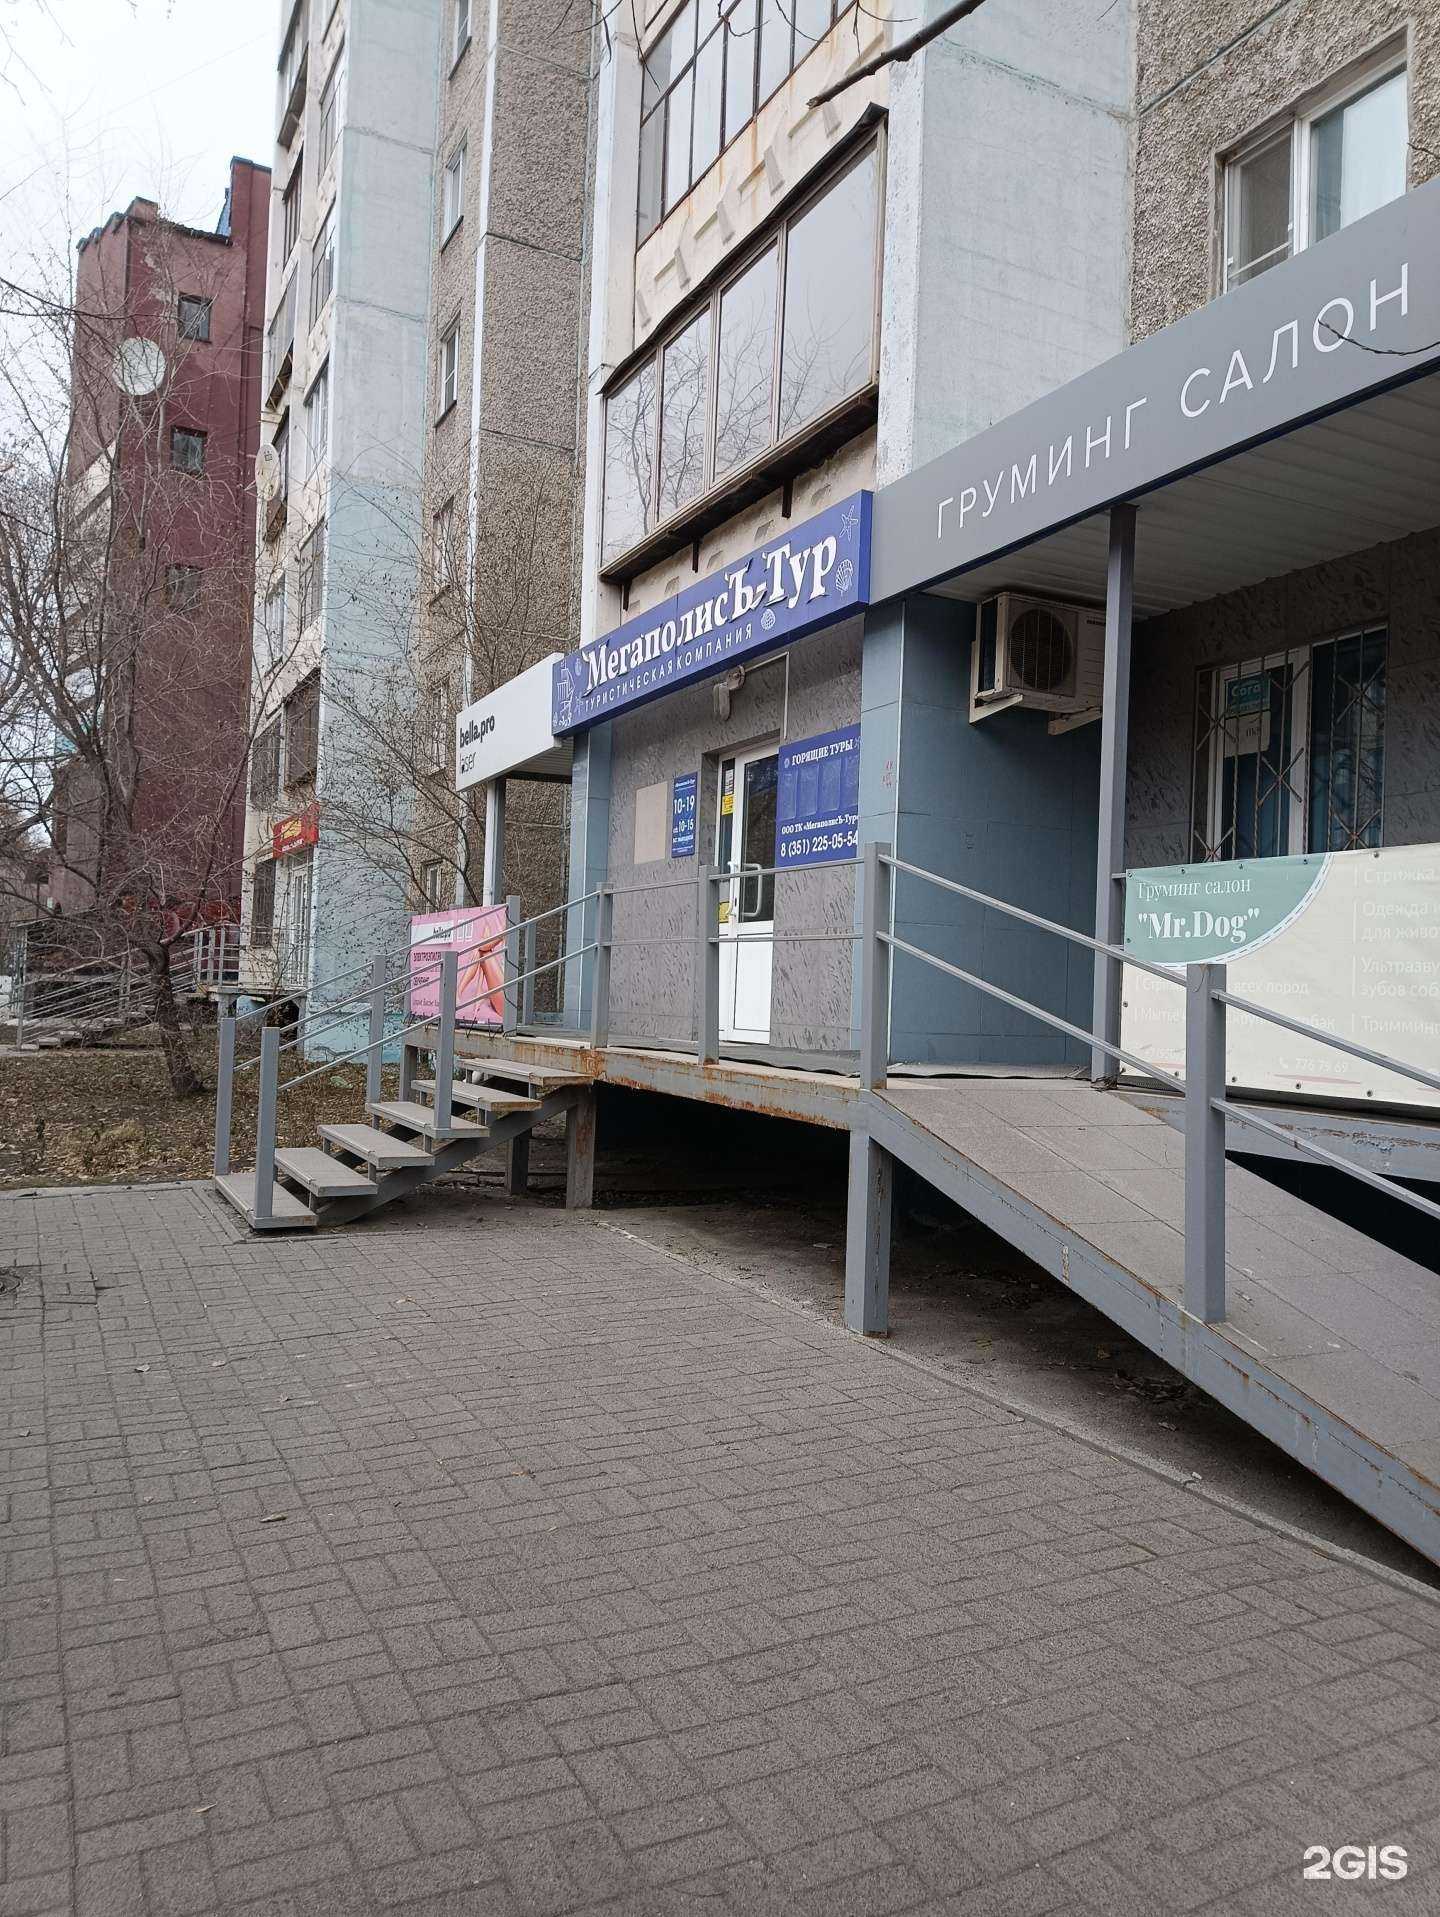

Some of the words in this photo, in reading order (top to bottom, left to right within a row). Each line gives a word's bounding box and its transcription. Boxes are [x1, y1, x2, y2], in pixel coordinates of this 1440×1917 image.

[937, 396, 1147, 541] ГРУМИНГ
[1180, 262, 1410, 419] САЛОН
[581, 534, 838, 699] МегаполисЪ-Тур
[583, 661, 674, 712] ТУРИСТИЧЕСКАЯ
[675, 623, 753, 672] КОМПАНИЯ
[459, 714, 496, 748] bella.pro
[791, 745, 829, 766] ГОРЯЩИЕ
[829, 738, 854, 756] ТУРЫ
[673, 794, 695, 815] 10-19
[678, 818, 694, 833] 10-15
[781, 825, 794, 835] ООО
[780, 842, 786, 857] 8
[788, 838, 810, 858] (351)
[812, 829, 859, 852] 225-05-54
[1136, 880, 1201, 903] Груминг
[1205, 878, 1252, 895] салон
[1362, 901, 1430, 919] Одежда
[1137, 906, 1261, 944] "Mr.Dog"
[1360, 926, 1392, 943] для
[1359, 979, 1407, 1000] зубов
